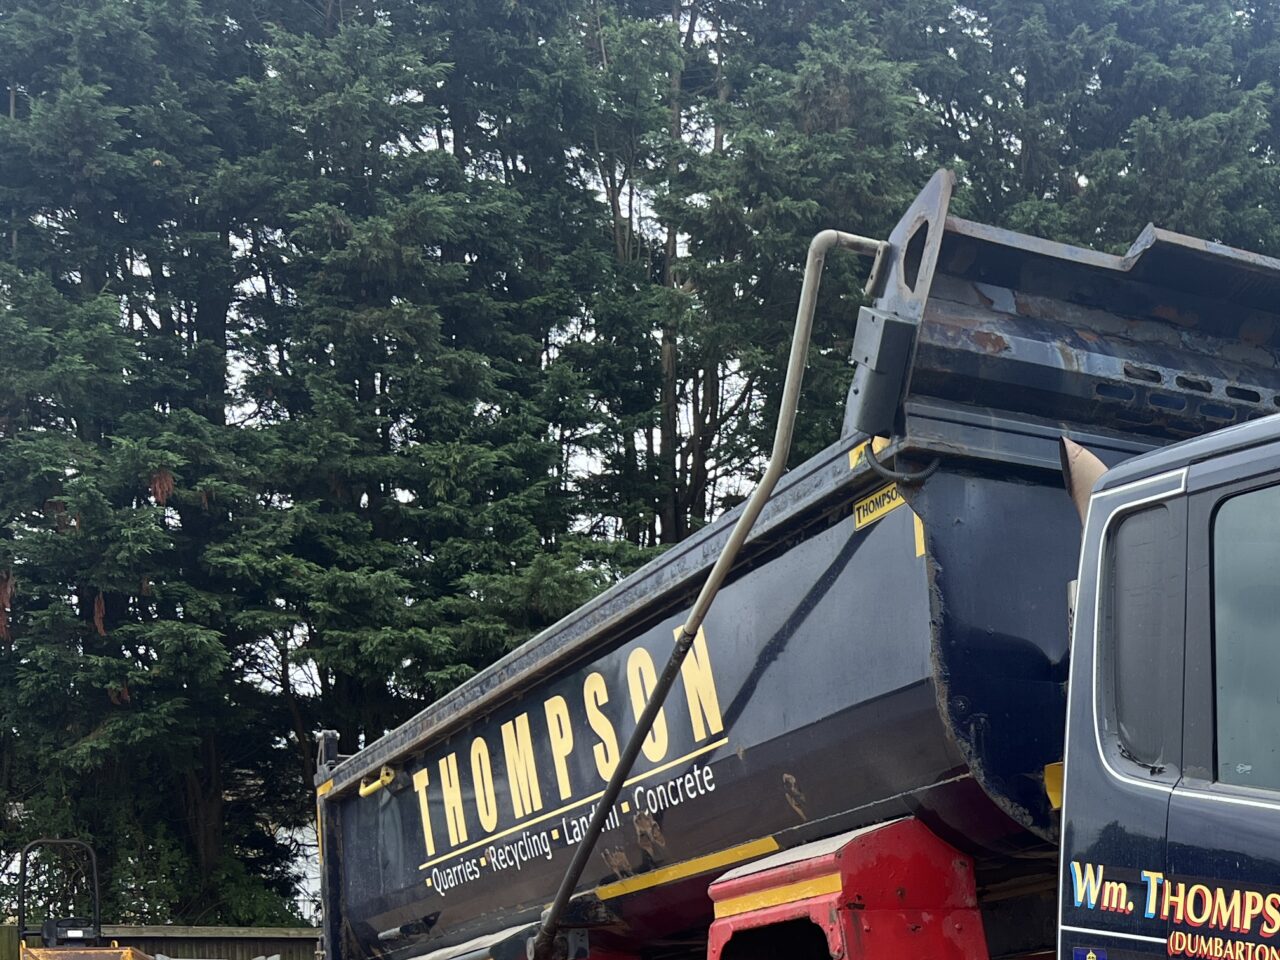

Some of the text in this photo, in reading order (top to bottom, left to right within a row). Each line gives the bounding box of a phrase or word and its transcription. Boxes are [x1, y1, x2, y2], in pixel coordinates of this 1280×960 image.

[856, 486, 900, 524] THOMPSO
[412, 624, 724, 857] THOMPSON
[431, 857, 480, 896] Quarries
[488, 831, 553, 871] Recycling
[634, 764, 716, 816] Concrete
[1070, 861, 1134, 914] Wm.
